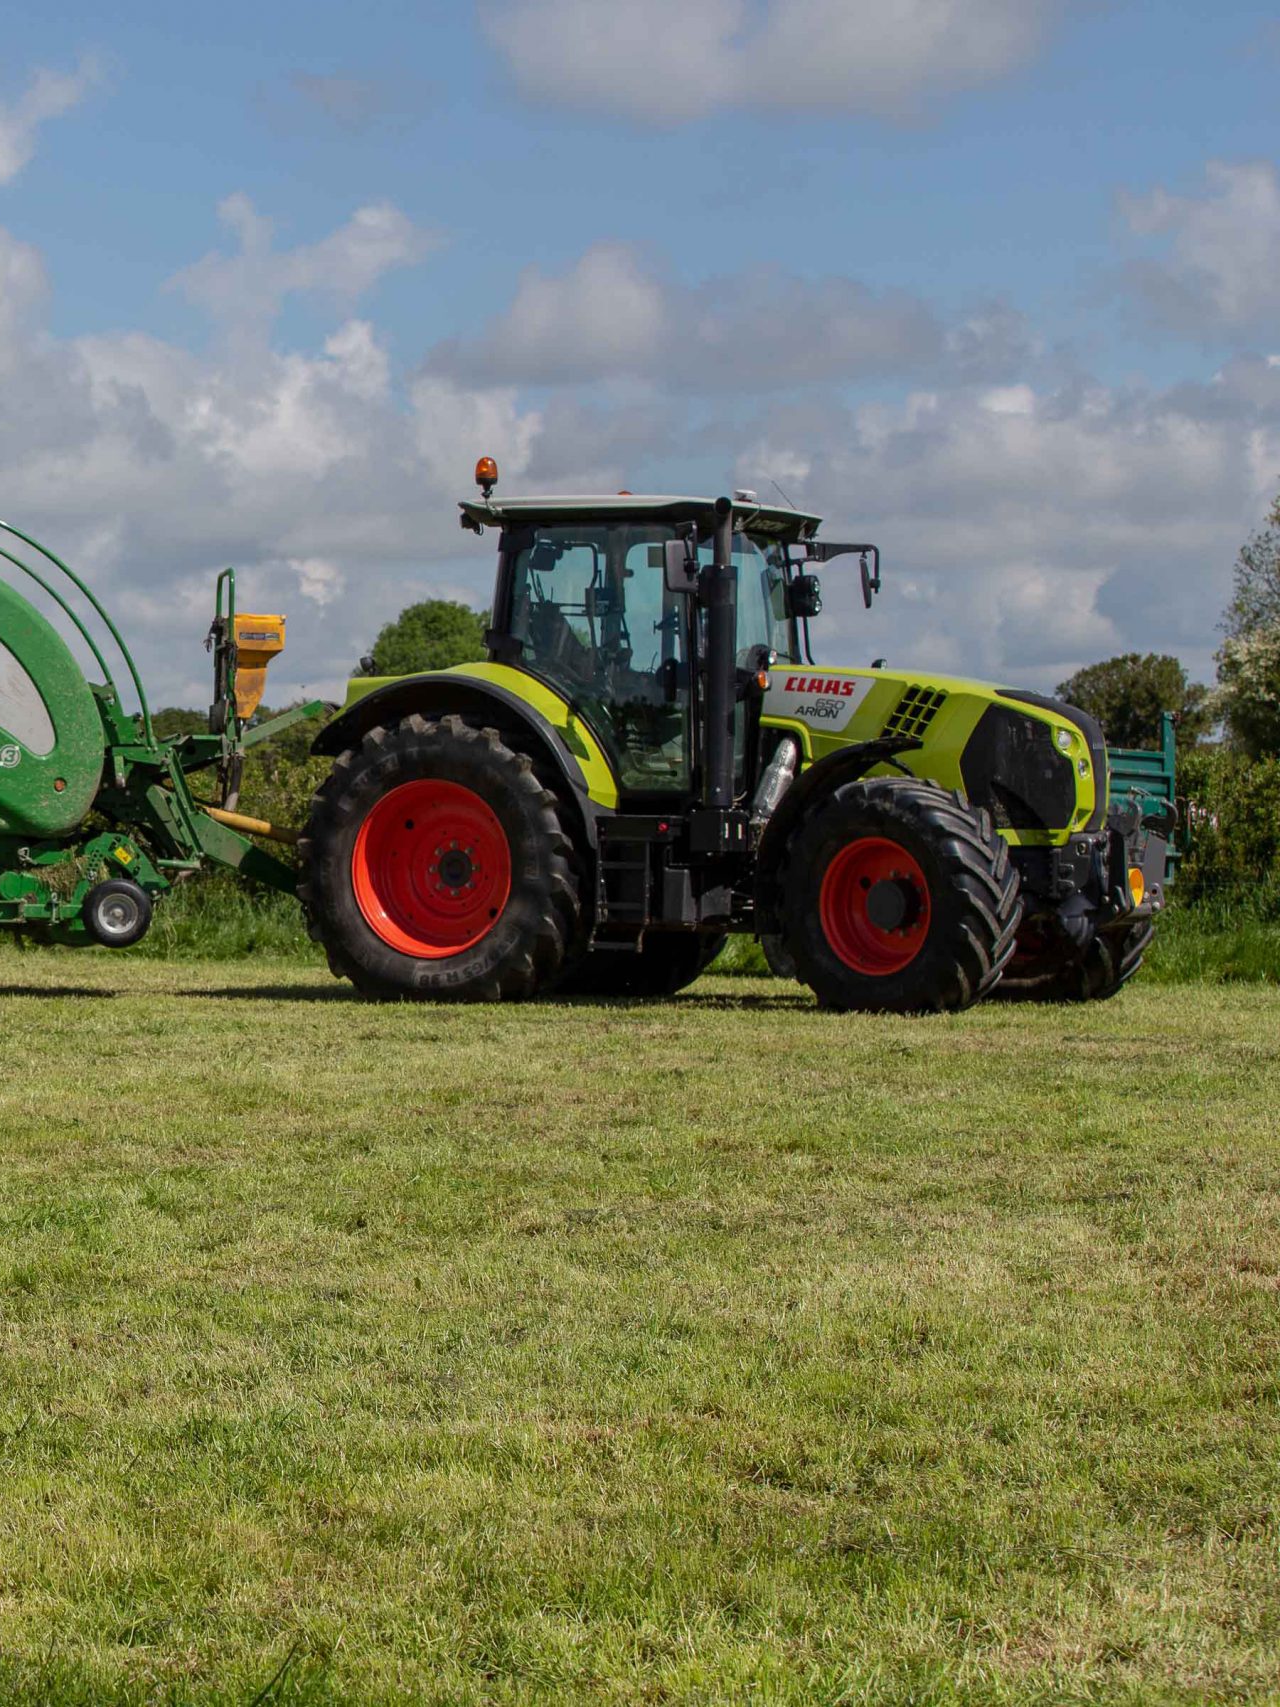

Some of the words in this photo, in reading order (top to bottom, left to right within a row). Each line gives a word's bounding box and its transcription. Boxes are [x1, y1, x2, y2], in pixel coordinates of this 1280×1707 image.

[784, 677, 856, 696] CLAAS
[815, 698, 846, 710] 650
[795, 705, 839, 719] ARION
